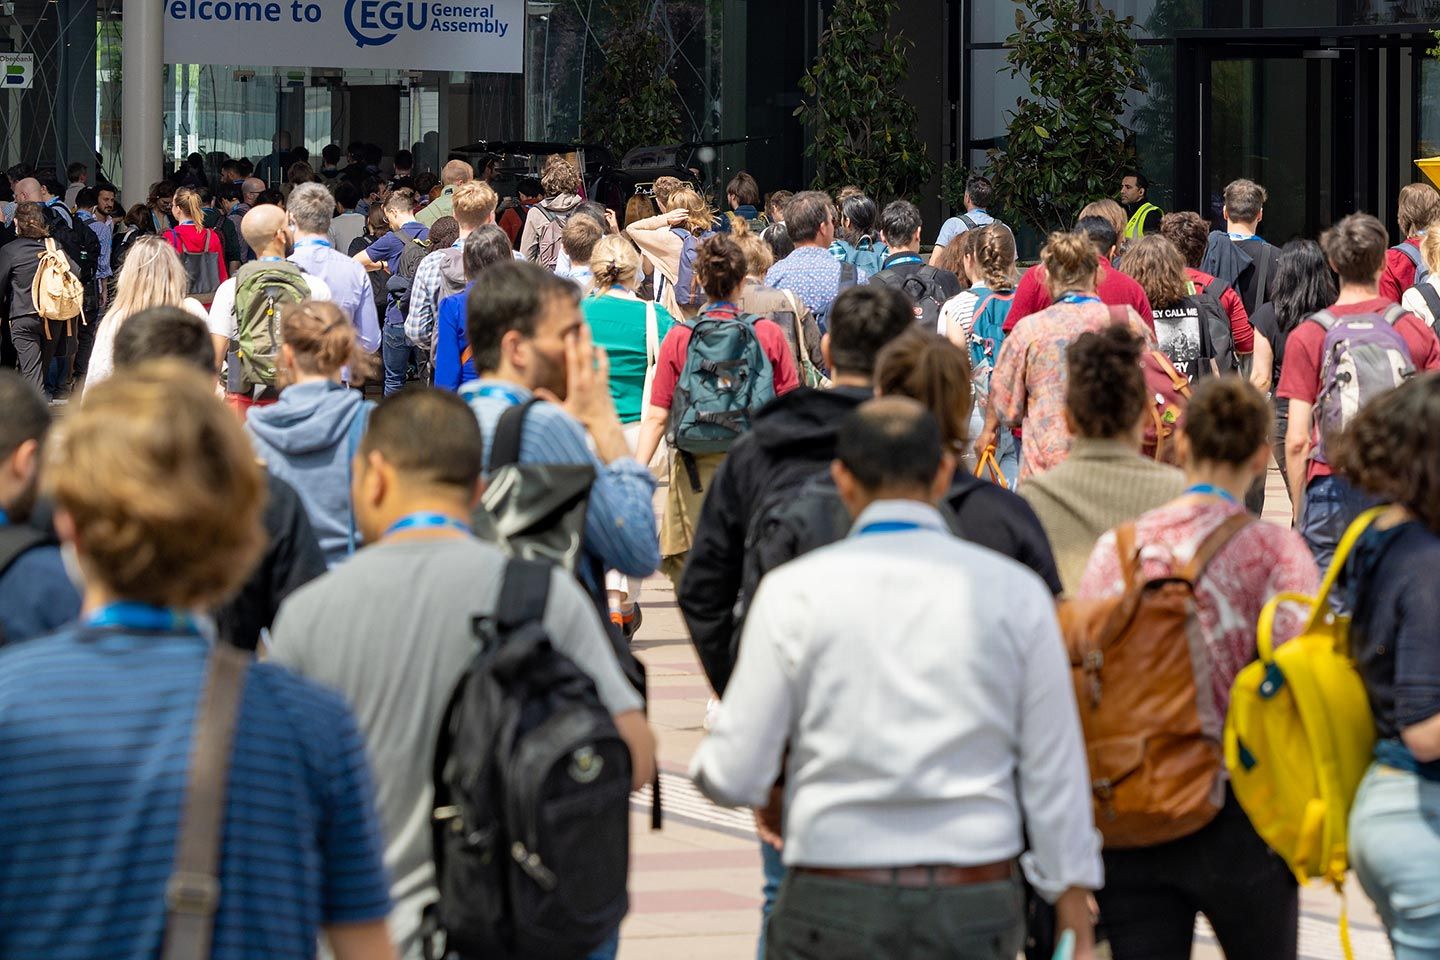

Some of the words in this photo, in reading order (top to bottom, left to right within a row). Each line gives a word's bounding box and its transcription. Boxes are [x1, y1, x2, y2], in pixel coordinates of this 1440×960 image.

[290, 0, 322, 23] to
[361, 0, 428, 31] EGU
[431, 3, 494, 18] General
[431, 18, 508, 38] Assembly
[1164, 308, 1186, 318] CALL
[1186, 307, 1198, 317] ME
